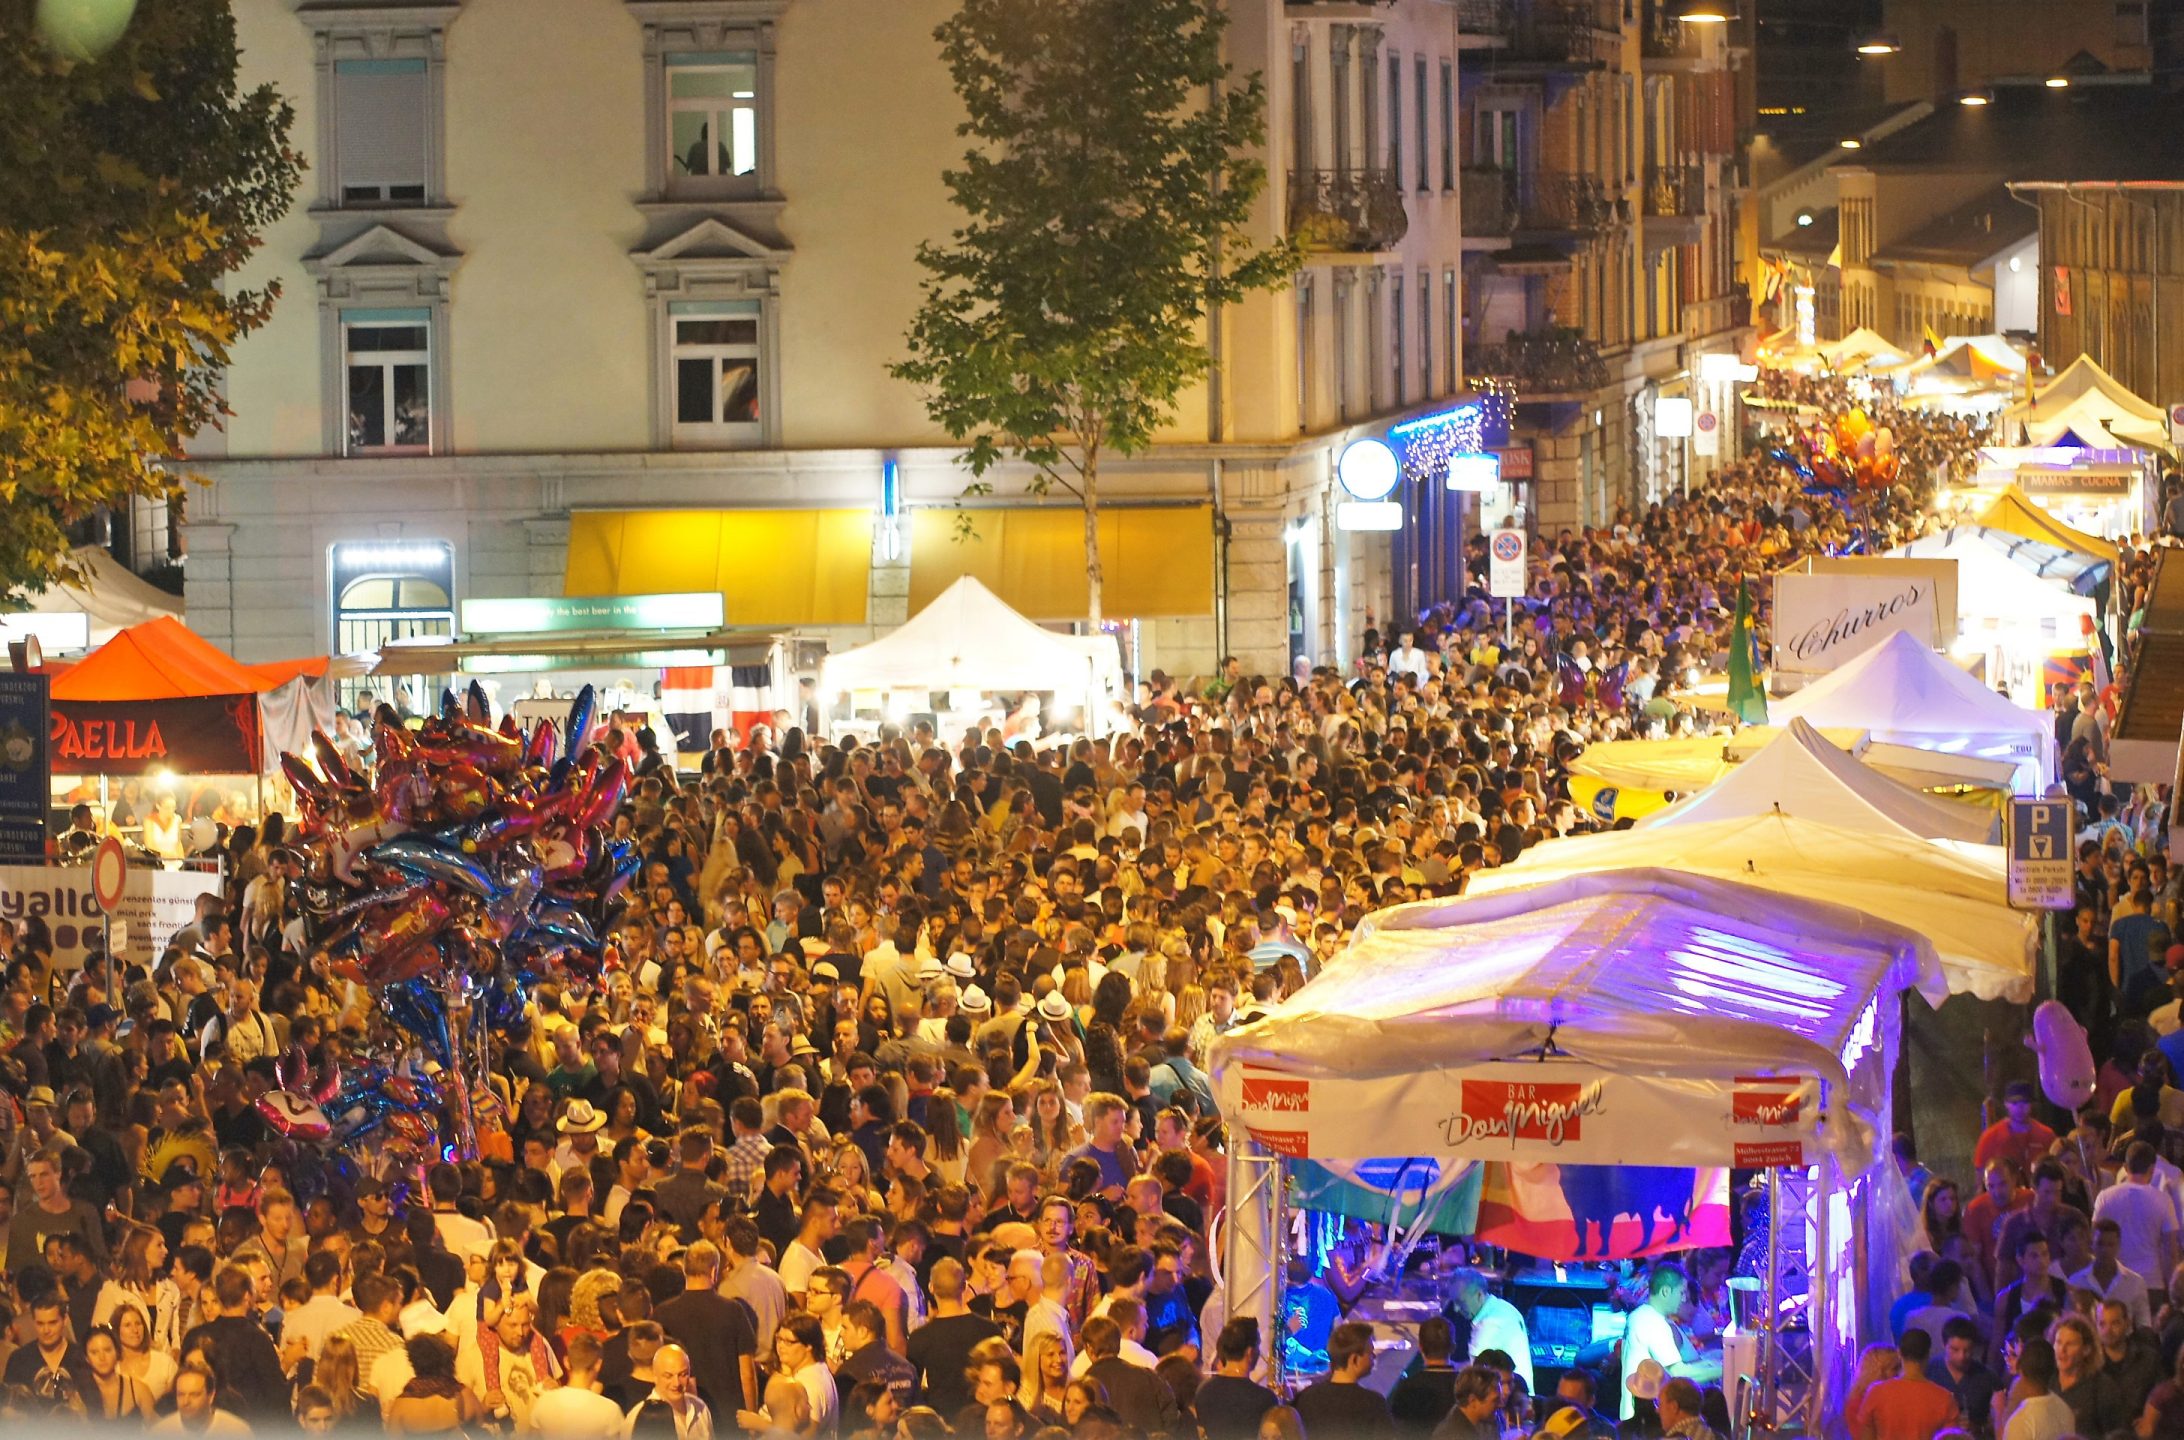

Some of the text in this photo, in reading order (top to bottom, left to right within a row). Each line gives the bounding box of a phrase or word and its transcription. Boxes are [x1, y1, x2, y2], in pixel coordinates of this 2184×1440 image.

[2031, 475, 2121, 487] MAMA'S CUCINA
[572, 605, 590, 616] best
[591, 605, 610, 615] beer
[1788, 585, 1926, 661] Churros
[2031, 805, 2050, 834] P
[2, 887, 102, 919] yallo
[123, 895, 167, 905] renzenlos
[116, 909, 138, 917] mini
[1507, 1083, 1536, 1100] BAR
[1438, 1079, 1608, 1150] Don Miguel
